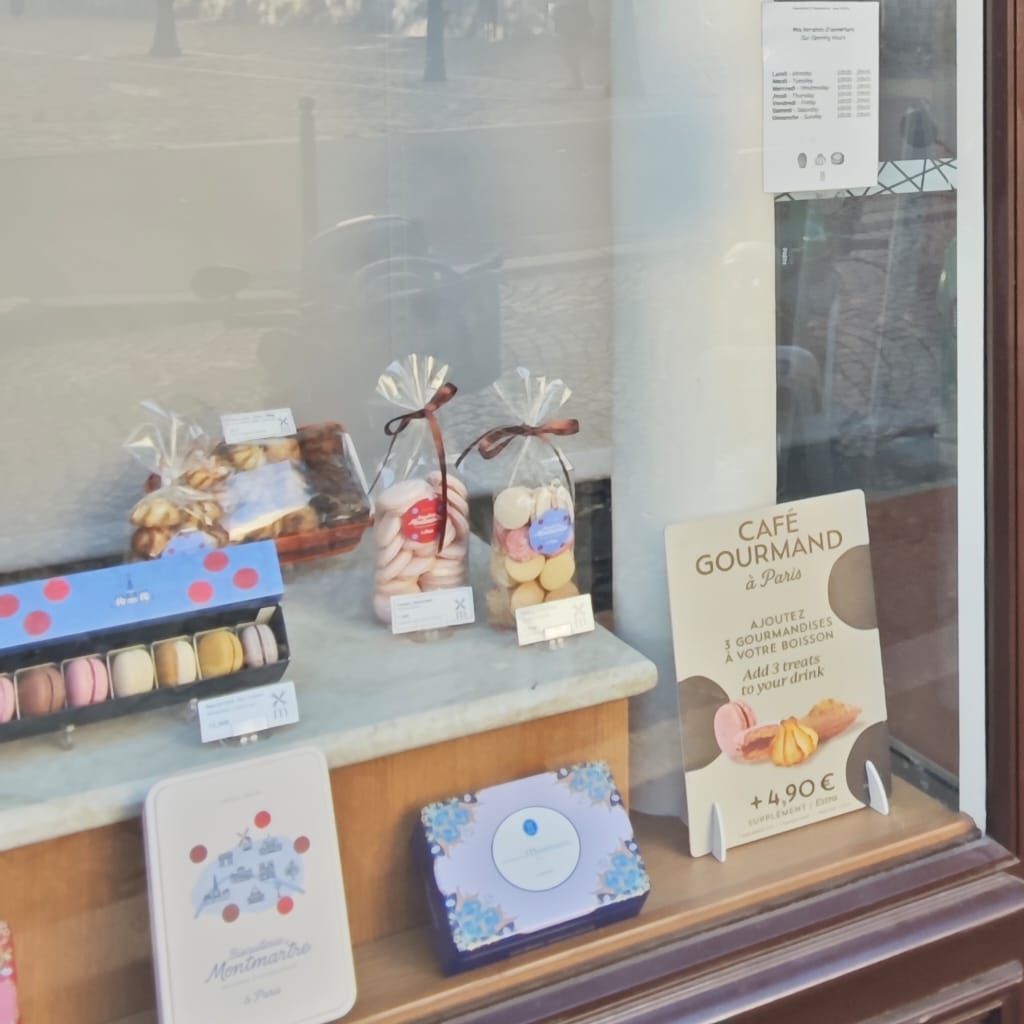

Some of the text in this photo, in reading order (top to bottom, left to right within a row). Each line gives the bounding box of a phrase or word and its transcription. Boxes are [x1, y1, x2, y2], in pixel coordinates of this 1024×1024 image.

[738, 507, 799, 541] CAFÉ
[695, 529, 843, 575] GOURMAND
[745, 568, 802, 591] à Paris
[725, 616, 833, 650] 3 GOURMANDISES
[751, 609, 805, 630] AJOUTEZ
[737, 643, 776, 660] VOTRE
[782, 630, 834, 651] BOISSON
[741, 666, 825, 696] to your drink
[742, 656, 821, 682] Add 3 treats
[768, 779, 815, 807] 4,90
[821, 772, 835, 791] €
